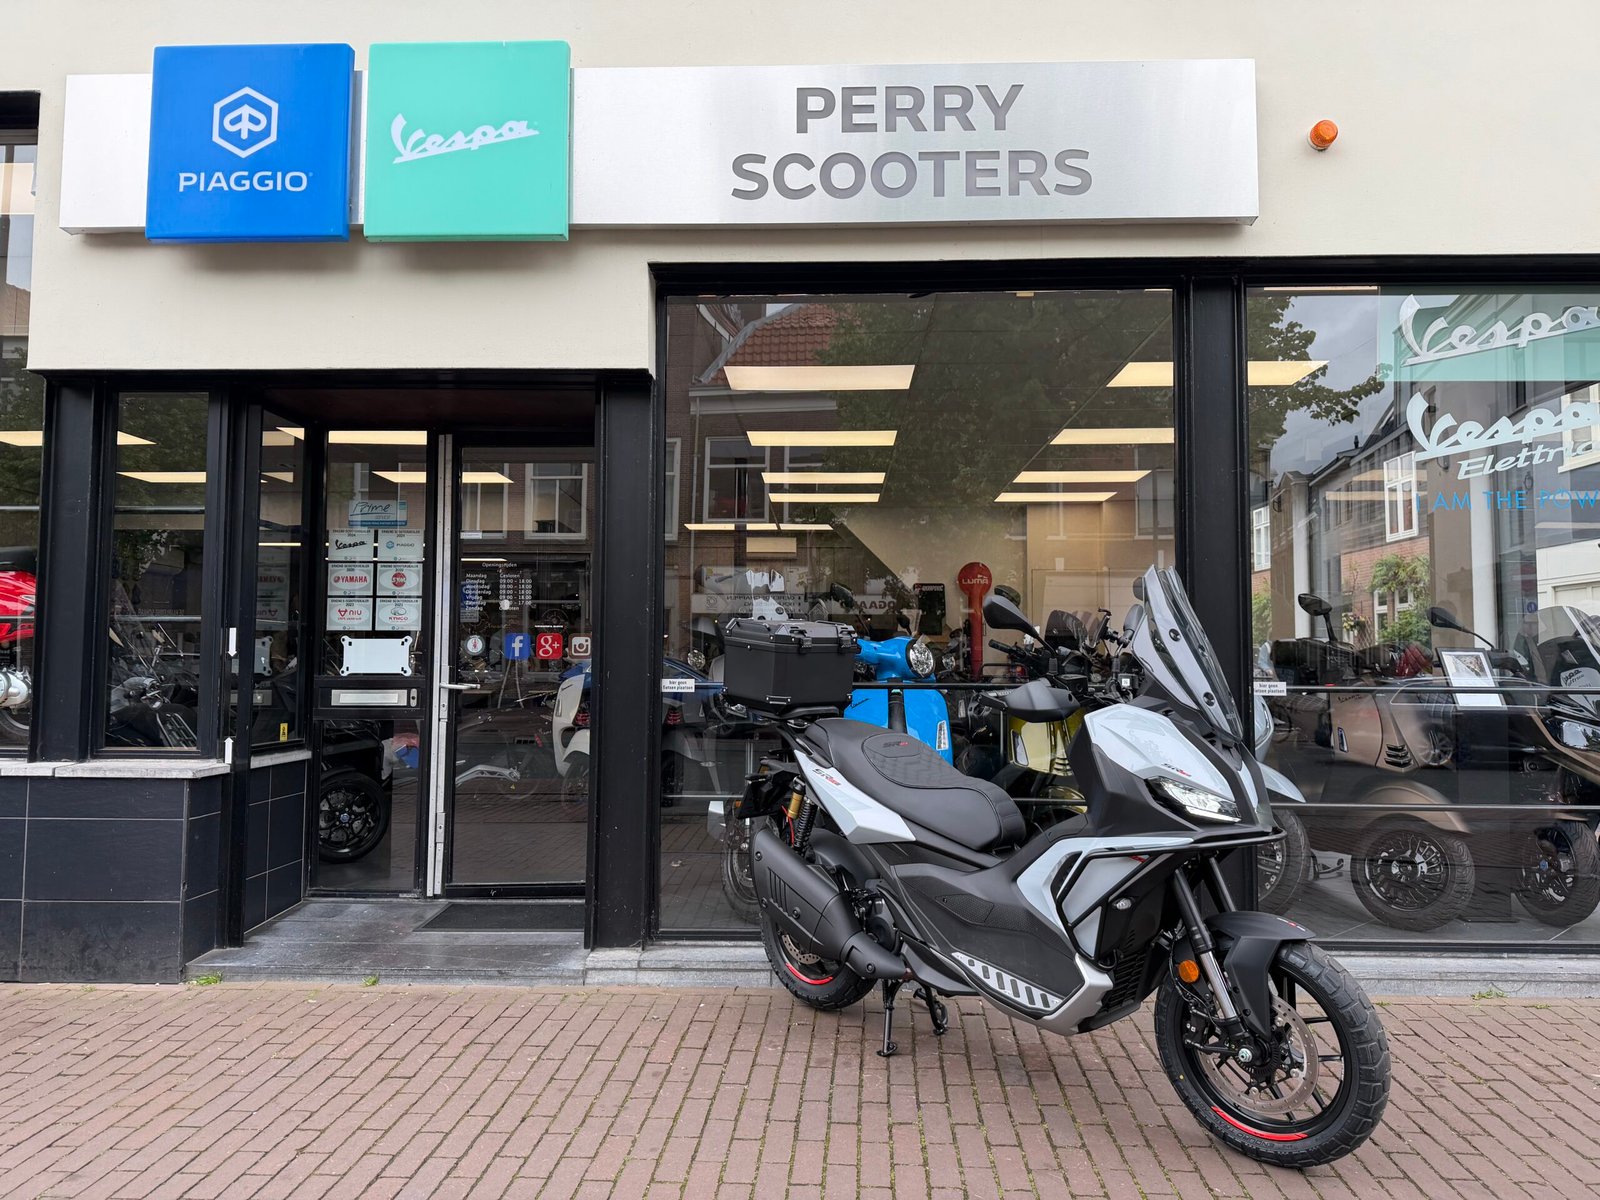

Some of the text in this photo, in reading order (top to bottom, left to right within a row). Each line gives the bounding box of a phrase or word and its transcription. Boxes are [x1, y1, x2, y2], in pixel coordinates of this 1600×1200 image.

[796, 84, 1024, 133] PERRY
[392, 113, 540, 164] Vespa
[178, 171, 308, 192] PIAGGIO
[731, 149, 1092, 200] SCOOTERS
[1401, 294, 1600, 367] Vespa
[1406, 392, 1600, 460] Vespa
[1432, 491, 1472, 512] AM
[1482, 489, 1527, 510] THE
[335, 539, 368, 551] Vespa
[341, 575, 368, 583] YAMAHA
